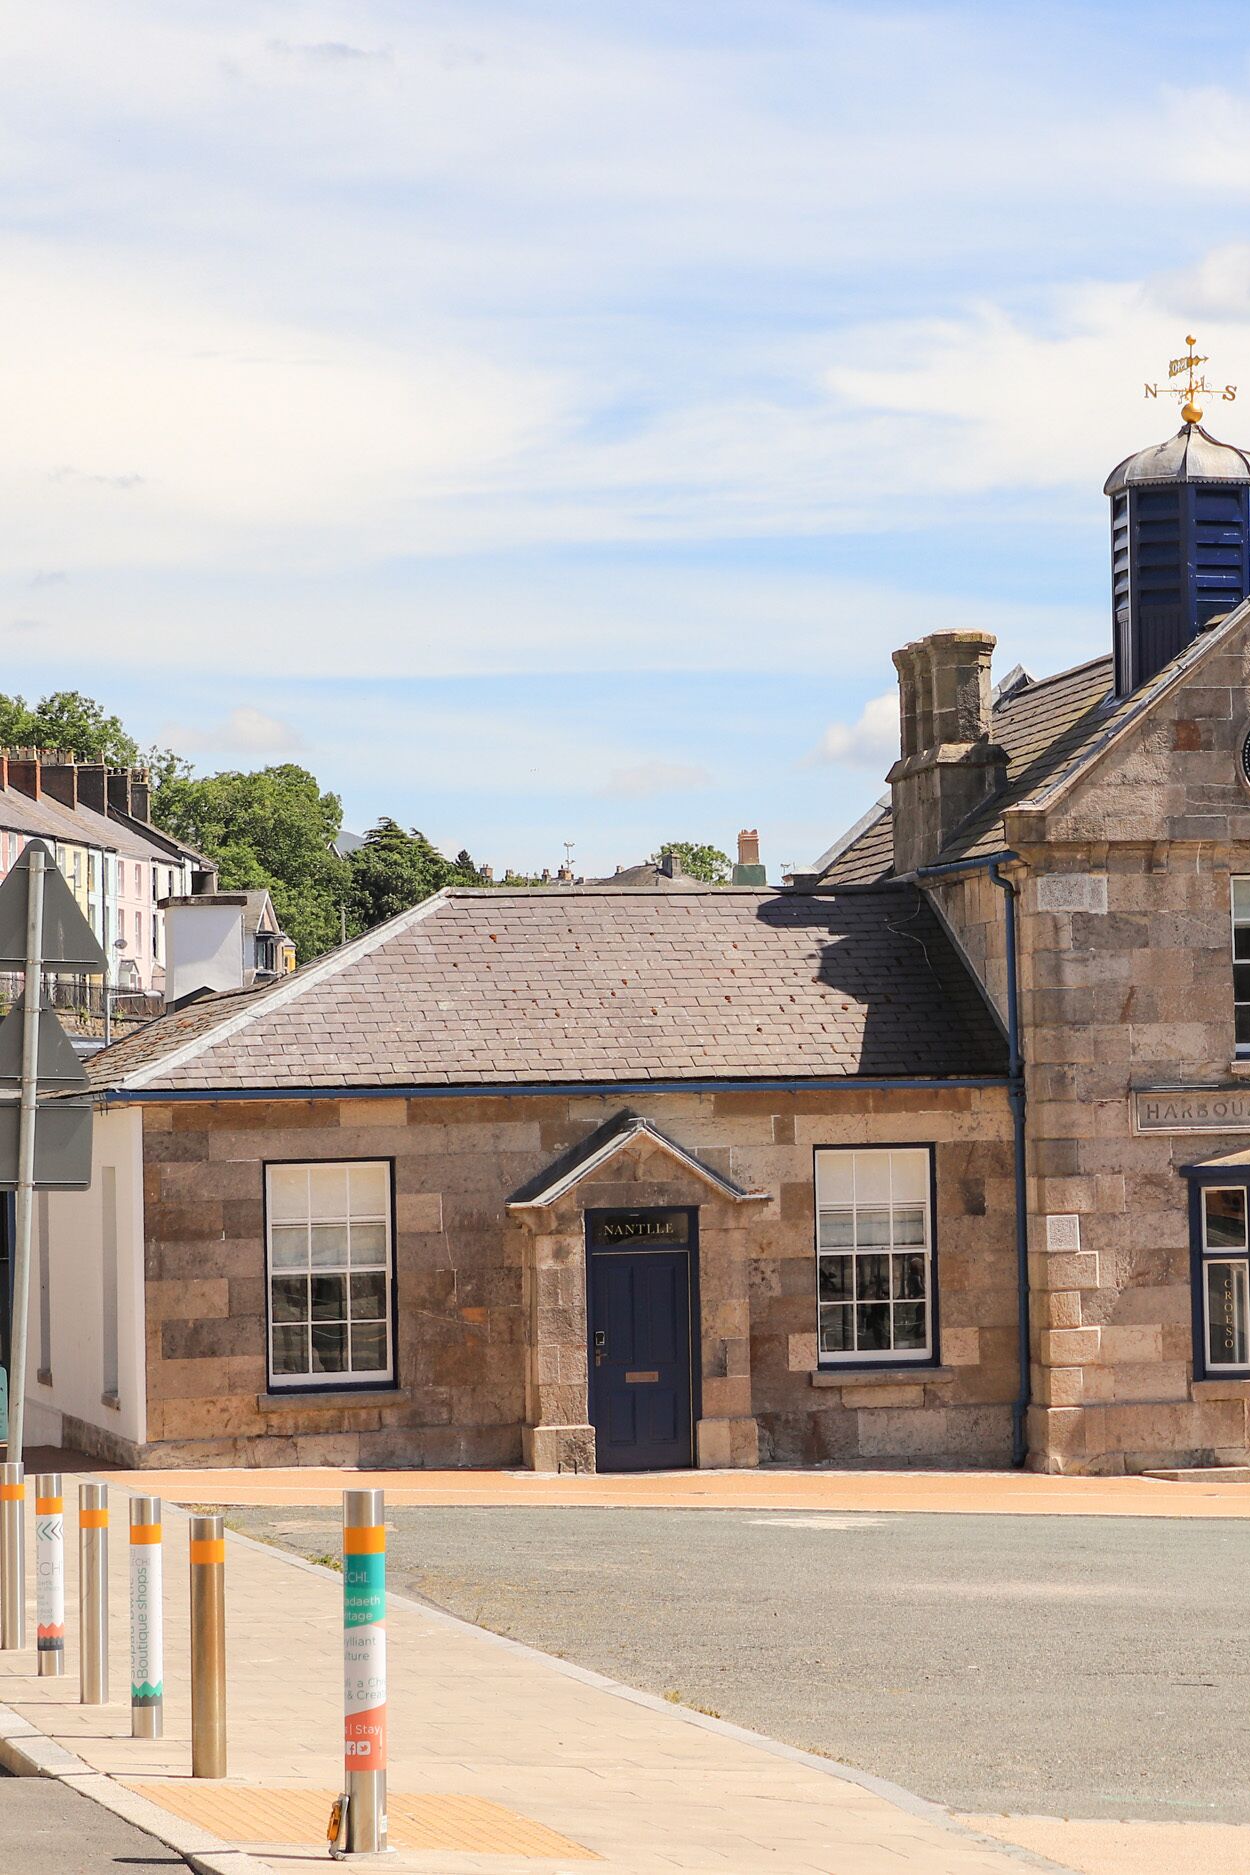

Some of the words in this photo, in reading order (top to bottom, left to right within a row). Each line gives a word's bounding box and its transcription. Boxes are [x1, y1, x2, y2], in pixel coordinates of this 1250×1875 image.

[1144, 383, 1158, 398] N
[1222, 385, 1238, 402] S
[604, 1222, 674, 1236] NANTLLE
[1224, 1279, 1234, 1349] CROESO
[135, 1567, 149, 1610] shops
[136, 1614, 150, 1679] Boutique
[355, 1723, 381, 1735] Stay
